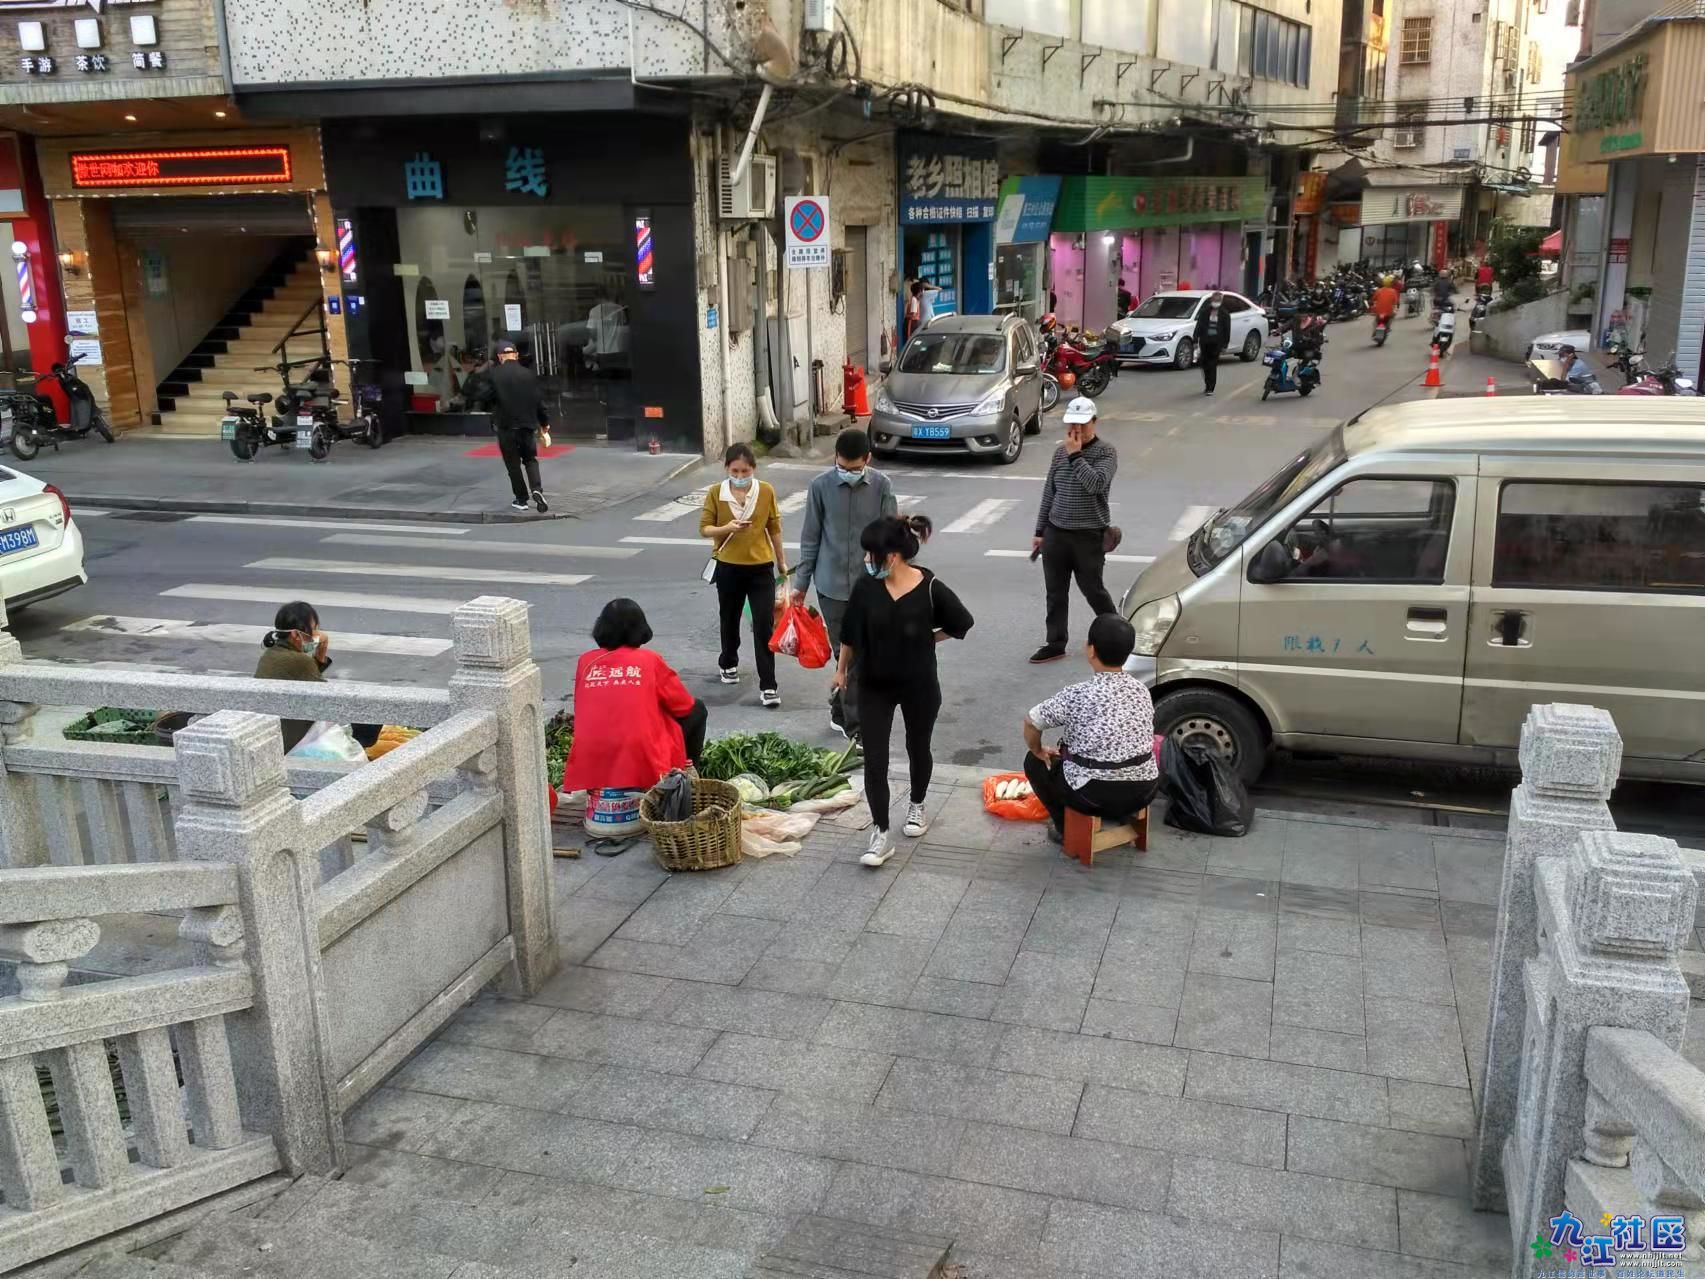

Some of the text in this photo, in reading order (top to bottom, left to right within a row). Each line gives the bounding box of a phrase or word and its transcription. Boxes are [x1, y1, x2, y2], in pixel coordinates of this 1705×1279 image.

[21, 52, 163, 73] 手游 茶饮 简餐
[405, 146, 548, 199] 曲线
